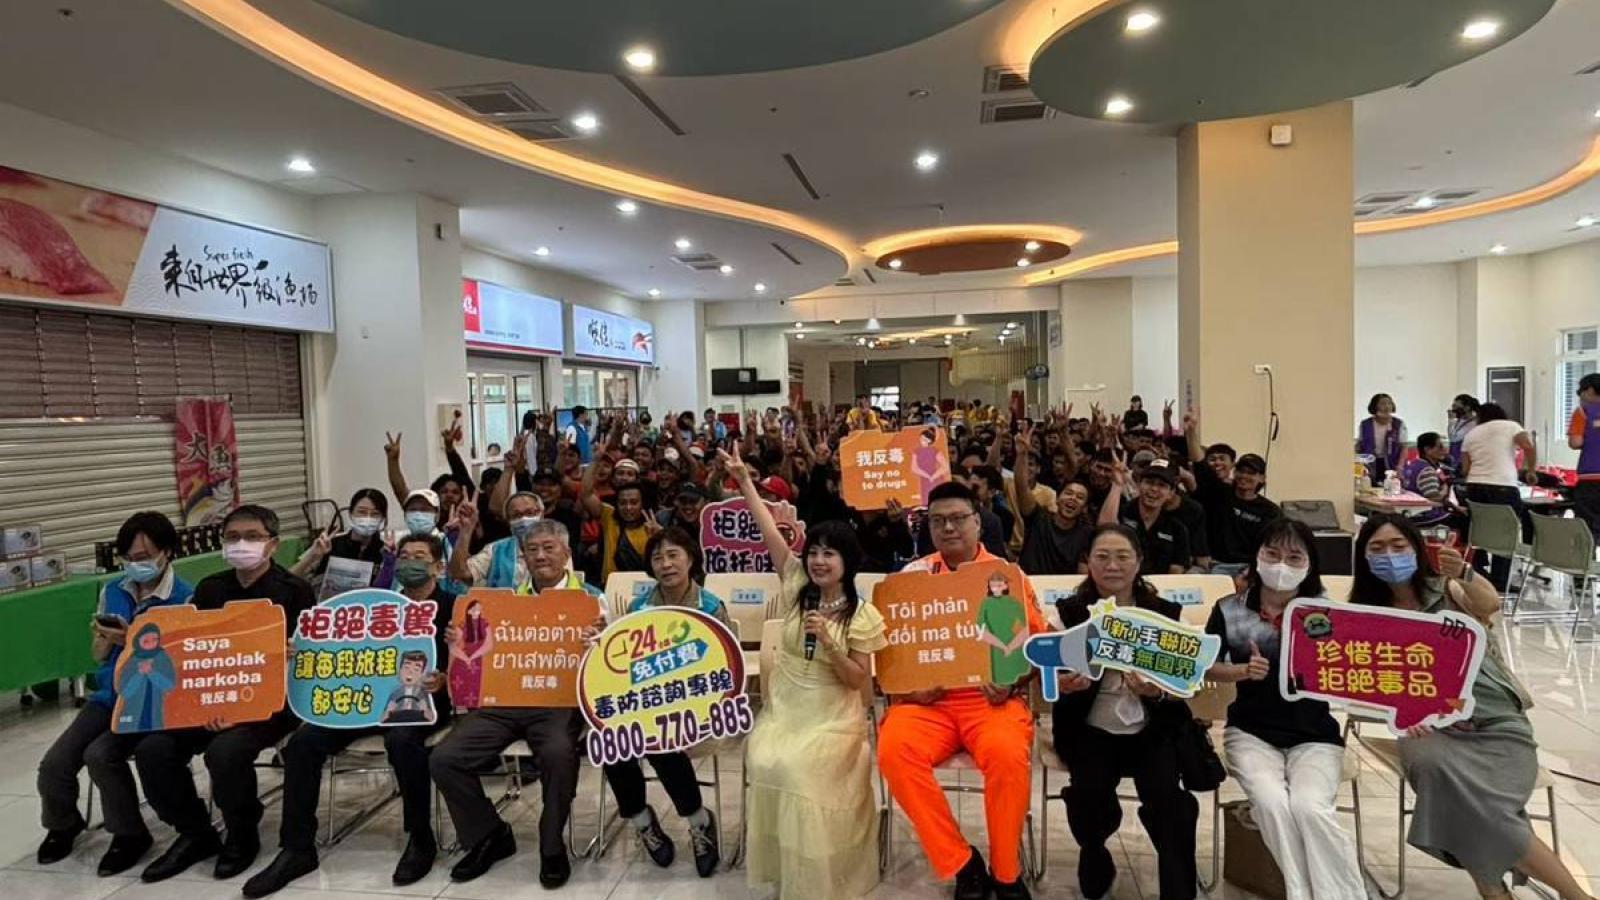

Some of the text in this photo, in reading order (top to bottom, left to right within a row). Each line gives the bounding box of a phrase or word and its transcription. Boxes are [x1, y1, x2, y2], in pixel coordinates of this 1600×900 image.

[856, 448, 904, 467] 我反毒
[862, 480, 907, 490] to drugs
[864, 470, 900, 480] Say no
[713, 510, 763, 540] 拒絕
[299, 603, 436, 640] 拒絕毒駕
[887, 596, 968, 621] Tôi phản
[629, 624, 658, 660] 24
[922, 627, 950, 642] ma
[955, 620, 986, 641] túy
[182, 637, 230, 654] Saya
[492, 648, 581, 670] ยาเสพติด
[1097, 639, 1195, 679] 反毒無國界
[1315, 639, 1435, 669] 珍惜生命
[182, 651, 267, 671] menolak
[295, 647, 397, 679] 讓每段旅程
[632, 642, 700, 682] 免付費
[181, 671, 262, 690] narkoba
[521, 675, 558, 689] 我反毒
[594, 667, 735, 720] 毒防諮詢專線
[1317, 666, 1437, 698] 拒絕毒品
[201, 690, 238, 706] 我反毒
[312, 684, 373, 715] 都安心
[588, 696, 752, 766] 0800-770-885
